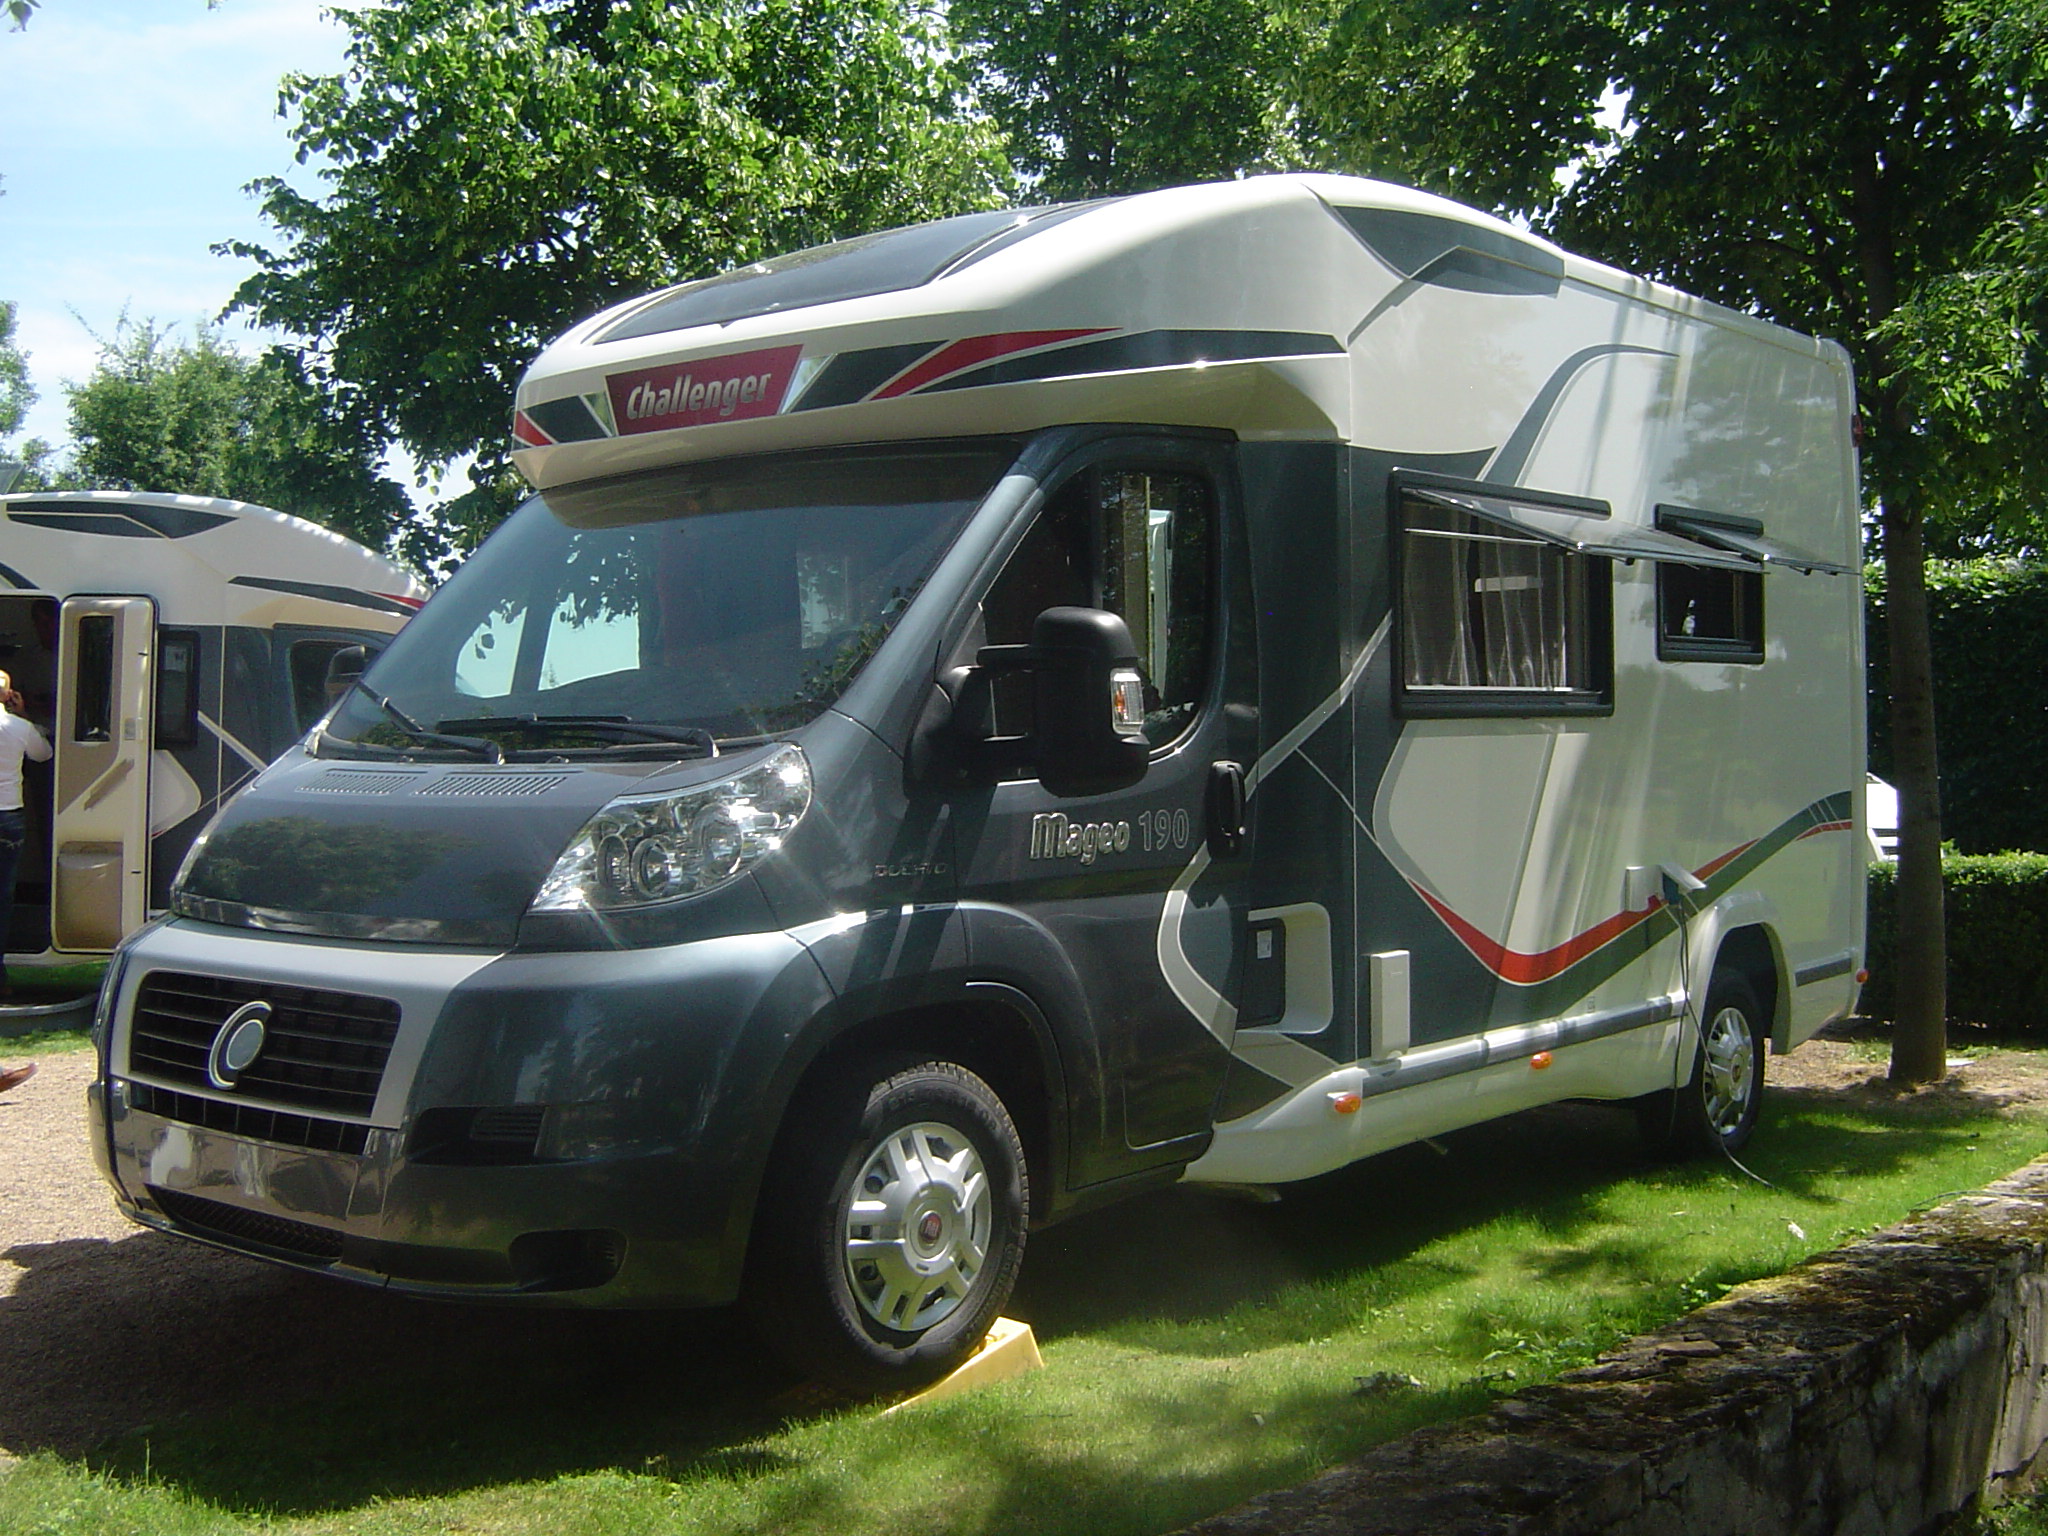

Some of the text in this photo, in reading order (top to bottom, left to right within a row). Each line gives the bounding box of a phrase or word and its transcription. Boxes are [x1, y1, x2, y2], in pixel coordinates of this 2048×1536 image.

[626, 373, 772, 420] Challenger
[1030, 808, 1190, 866] Mageo 190
